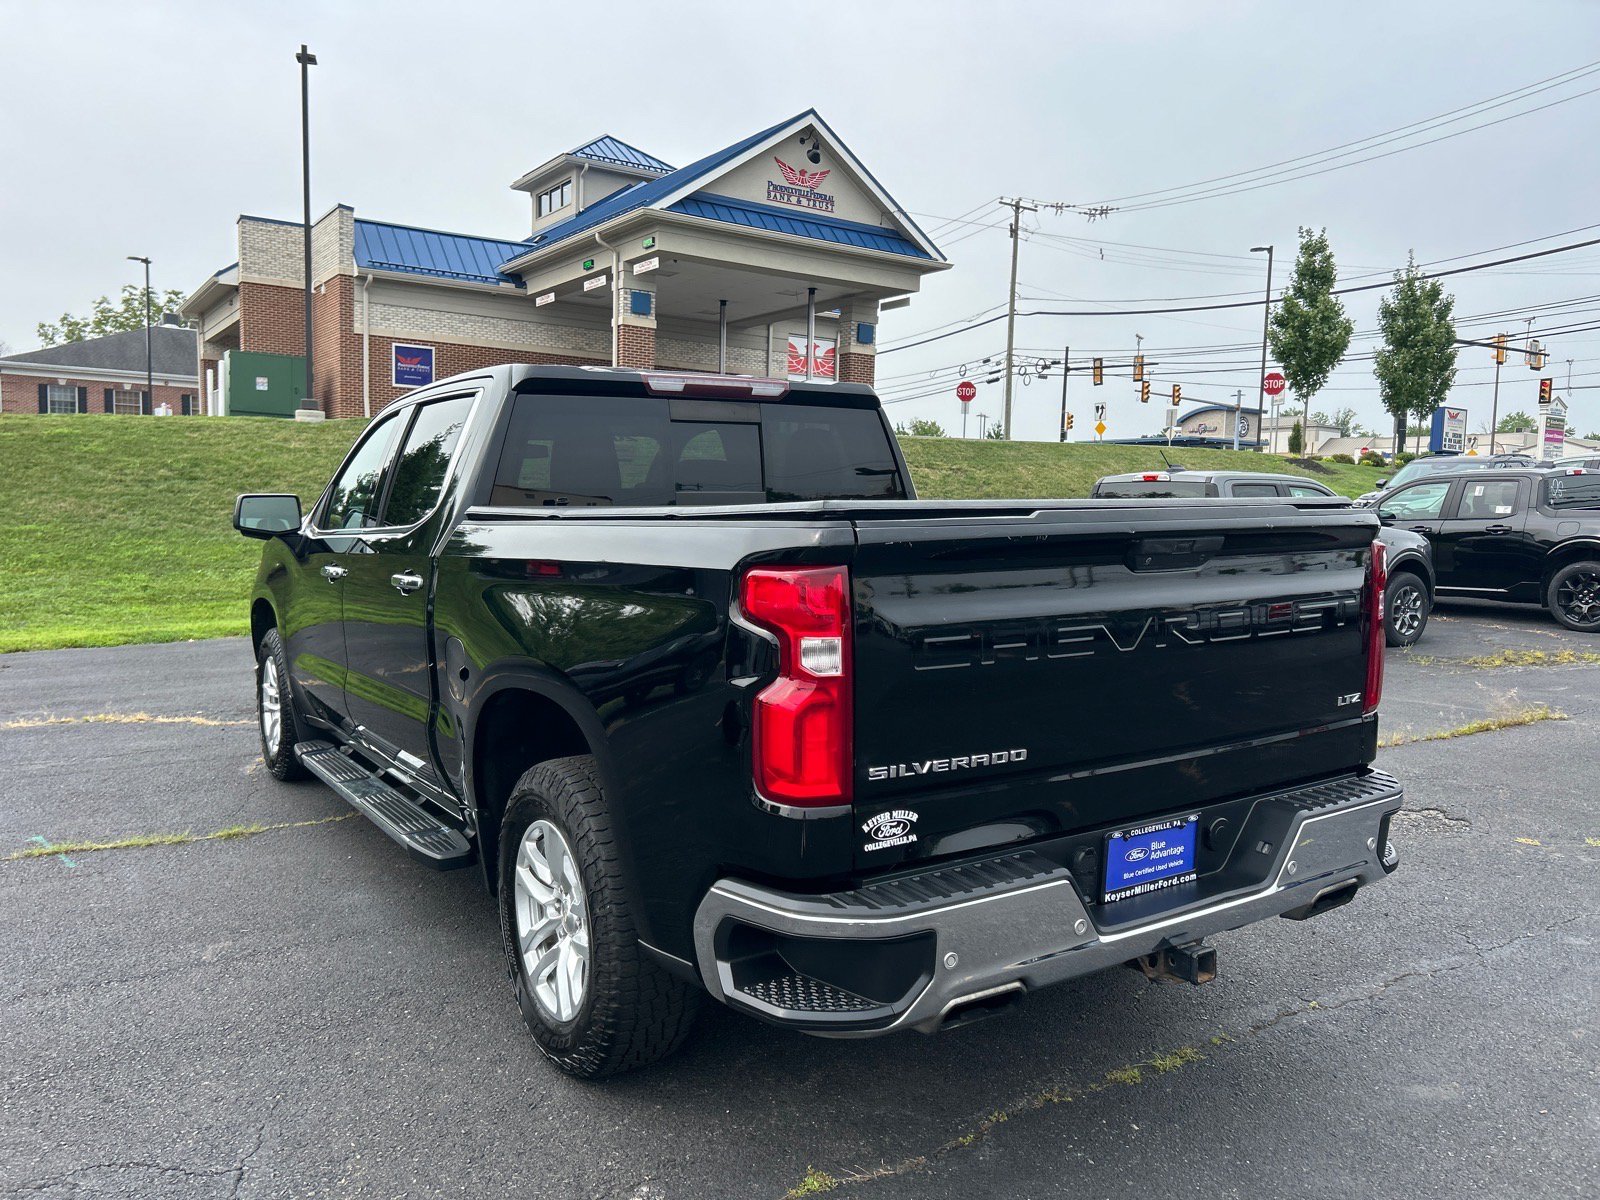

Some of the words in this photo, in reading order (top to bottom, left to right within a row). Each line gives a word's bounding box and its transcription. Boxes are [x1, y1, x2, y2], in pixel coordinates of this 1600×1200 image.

[767, 191, 792, 203] BANK
[796, 197, 802, 205] &
[806, 198, 835, 211] TRUST
[957, 387, 976, 396] STOP
[1263, 379, 1285, 389] STOP
[1337, 692, 1361, 706] LTZ
[868, 749, 1028, 781] SILVERADO
[861, 811, 891, 833] KEYSER
[891, 809, 919, 823] MILLER
[877, 821, 904, 838] Ford
[1130, 822, 1172, 837] COLLEGEVILLE,
[1128, 848, 1146, 860] Ford
[1150, 845, 1185, 860] Advantage
[1151, 841, 1166, 851] Blue
[1123, 872, 1134, 880] Blue
[1134, 865, 1155, 877] Certified
[1155, 863, 1168, 872] Used
[1168, 859, 1184, 868] Vehicle
[1104, 873, 1197, 903] KeyserMillerFord.com
